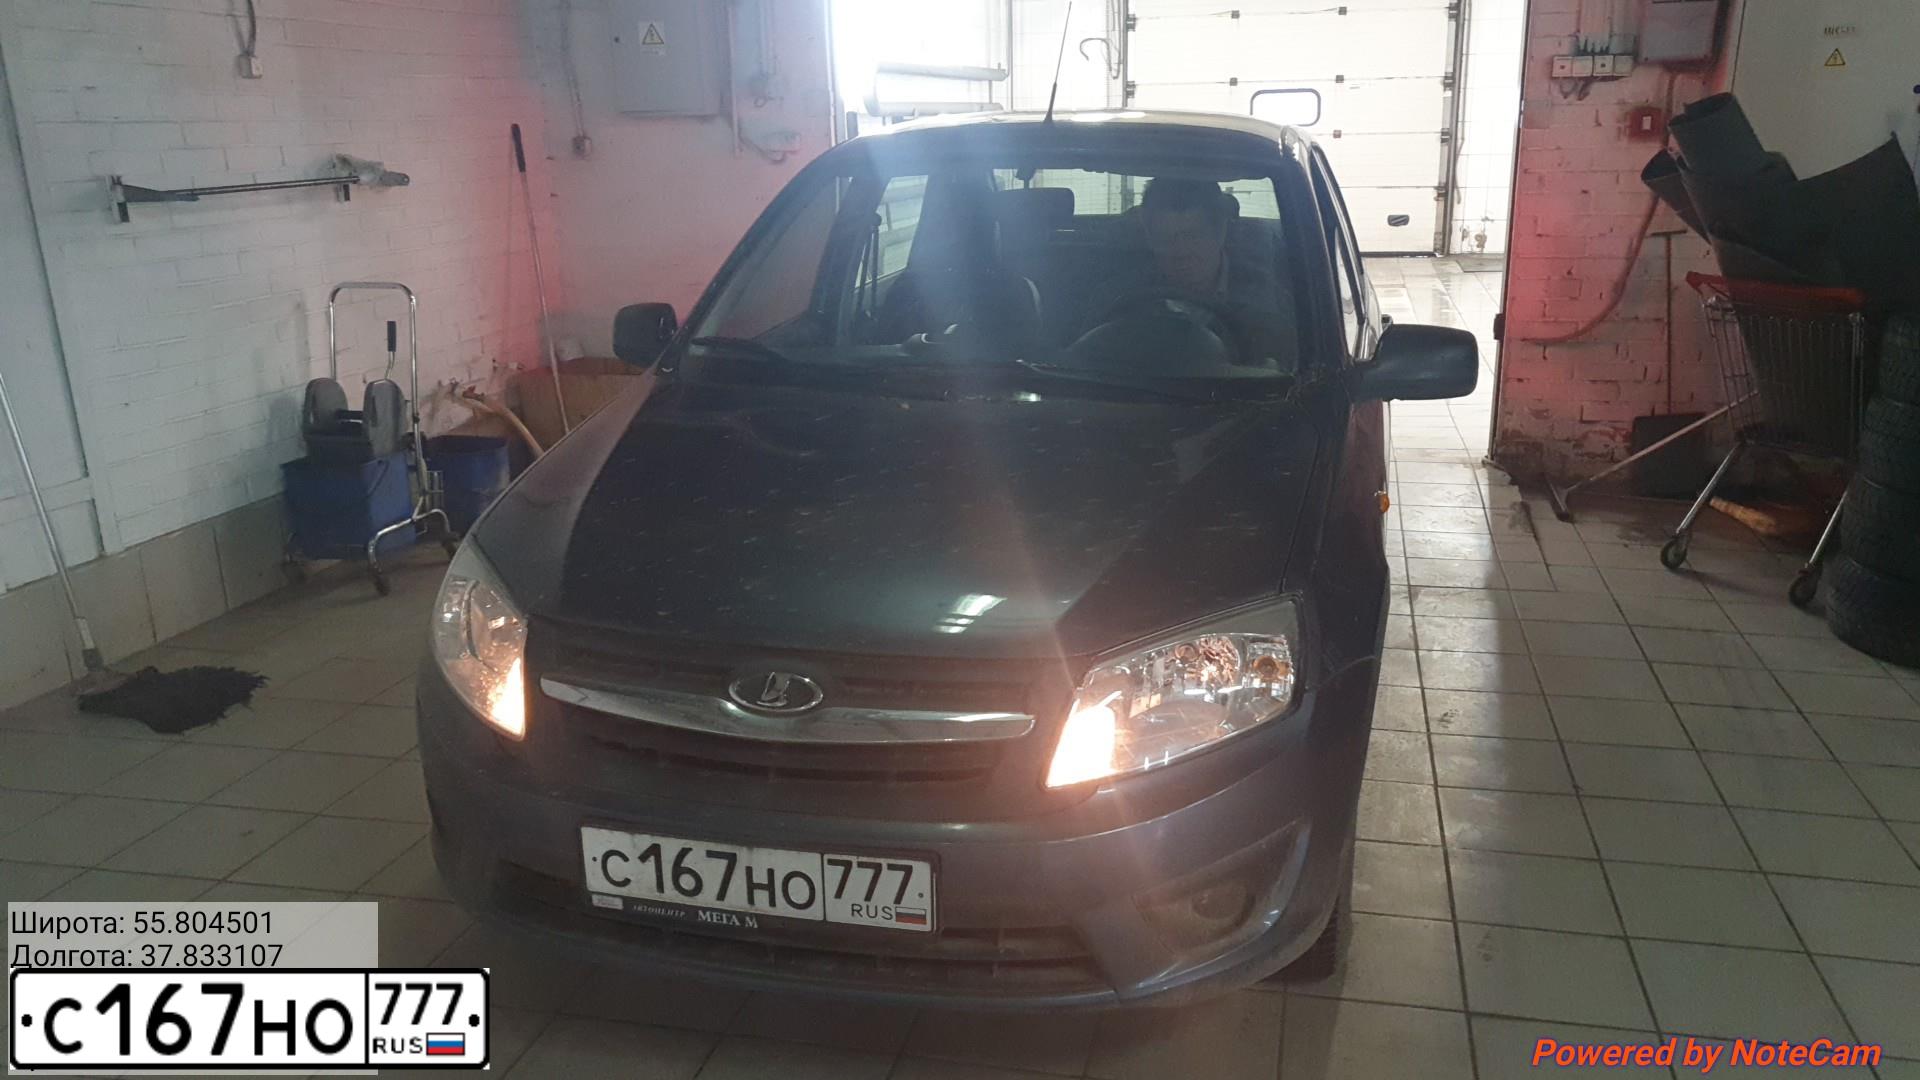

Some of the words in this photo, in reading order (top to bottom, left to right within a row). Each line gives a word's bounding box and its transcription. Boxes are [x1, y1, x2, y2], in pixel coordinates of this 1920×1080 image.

[827, 858, 914, 905] 777
[697, 909, 741, 927] МЕГА
[744, 915, 759, 929] М
[850, 903, 894, 921] RUS
